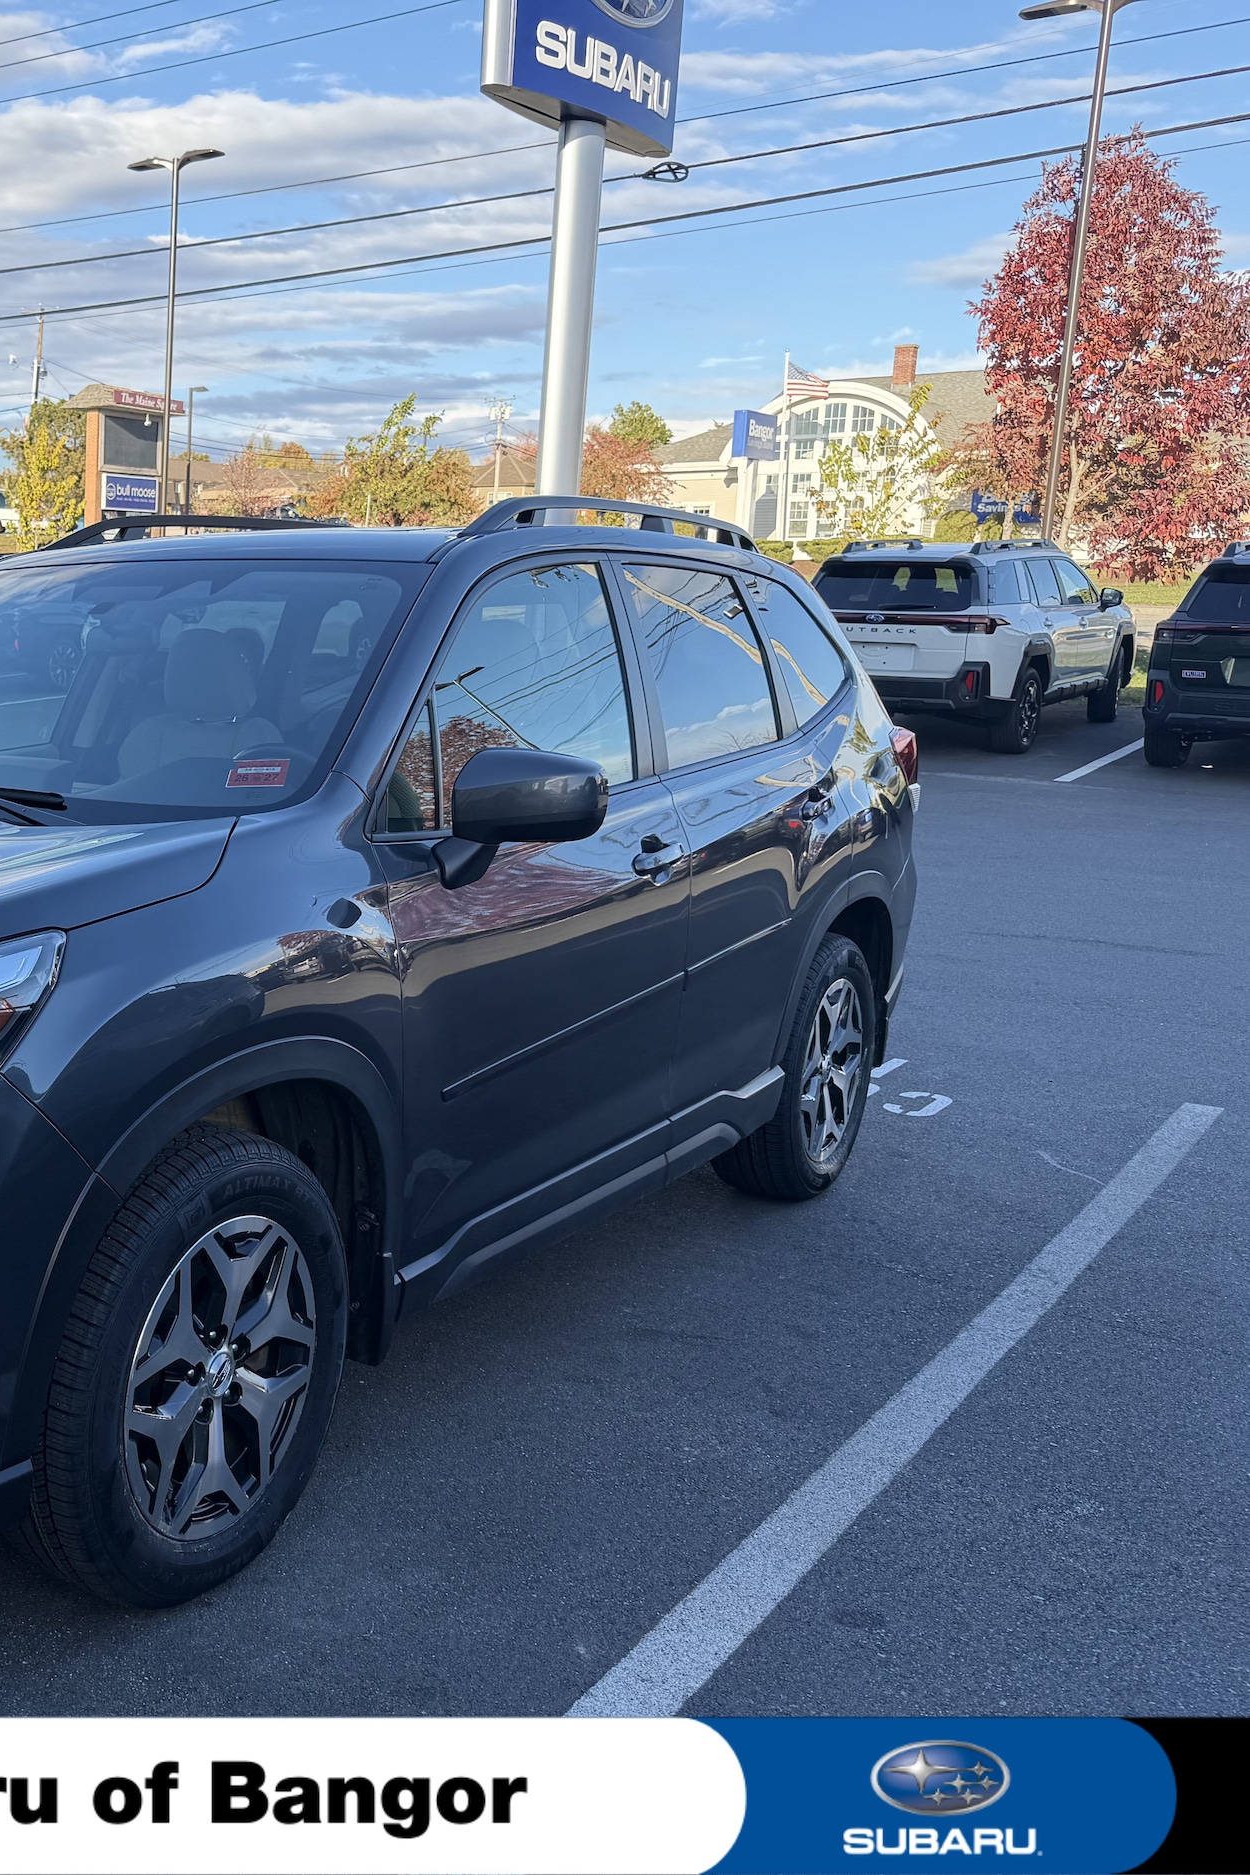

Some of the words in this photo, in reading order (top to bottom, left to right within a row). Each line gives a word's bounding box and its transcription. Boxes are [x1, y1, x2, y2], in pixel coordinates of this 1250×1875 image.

[535, 20, 671, 119] SUBARU
[121, 392, 134, 404] The
[135, 394, 156, 408] Maine
[156, 399, 178, 411] Sqre
[749, 419, 774, 442] Bangor
[116, 483, 130, 496] bull
[131, 487, 156, 498] moose
[977, 502, 1021, 513] Savins
[846, 626, 917, 634] UTBACK
[234, 773, 249, 782] 26
